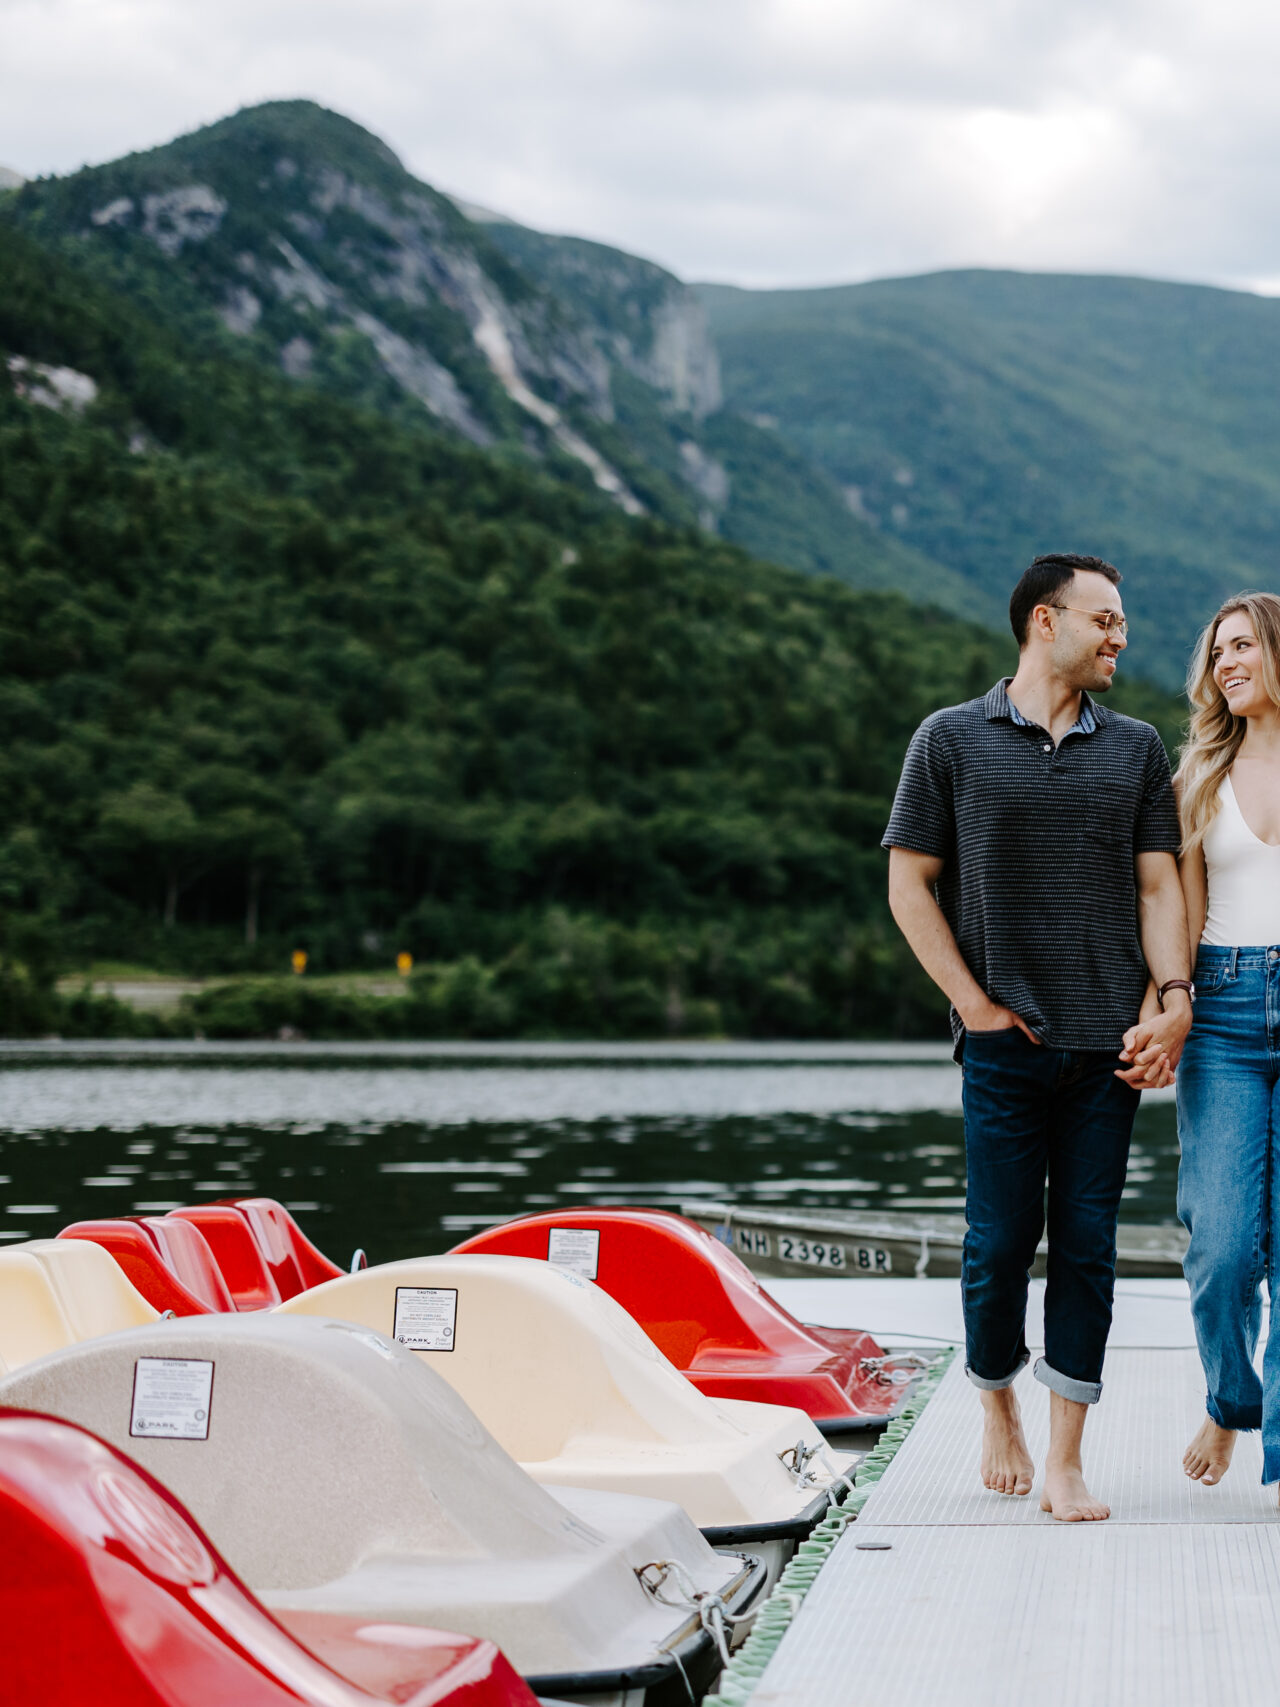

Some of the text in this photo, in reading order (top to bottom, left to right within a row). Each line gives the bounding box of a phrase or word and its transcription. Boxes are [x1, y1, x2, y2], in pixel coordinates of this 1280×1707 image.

[740, 1232, 887, 1271] NH 2398 BR
